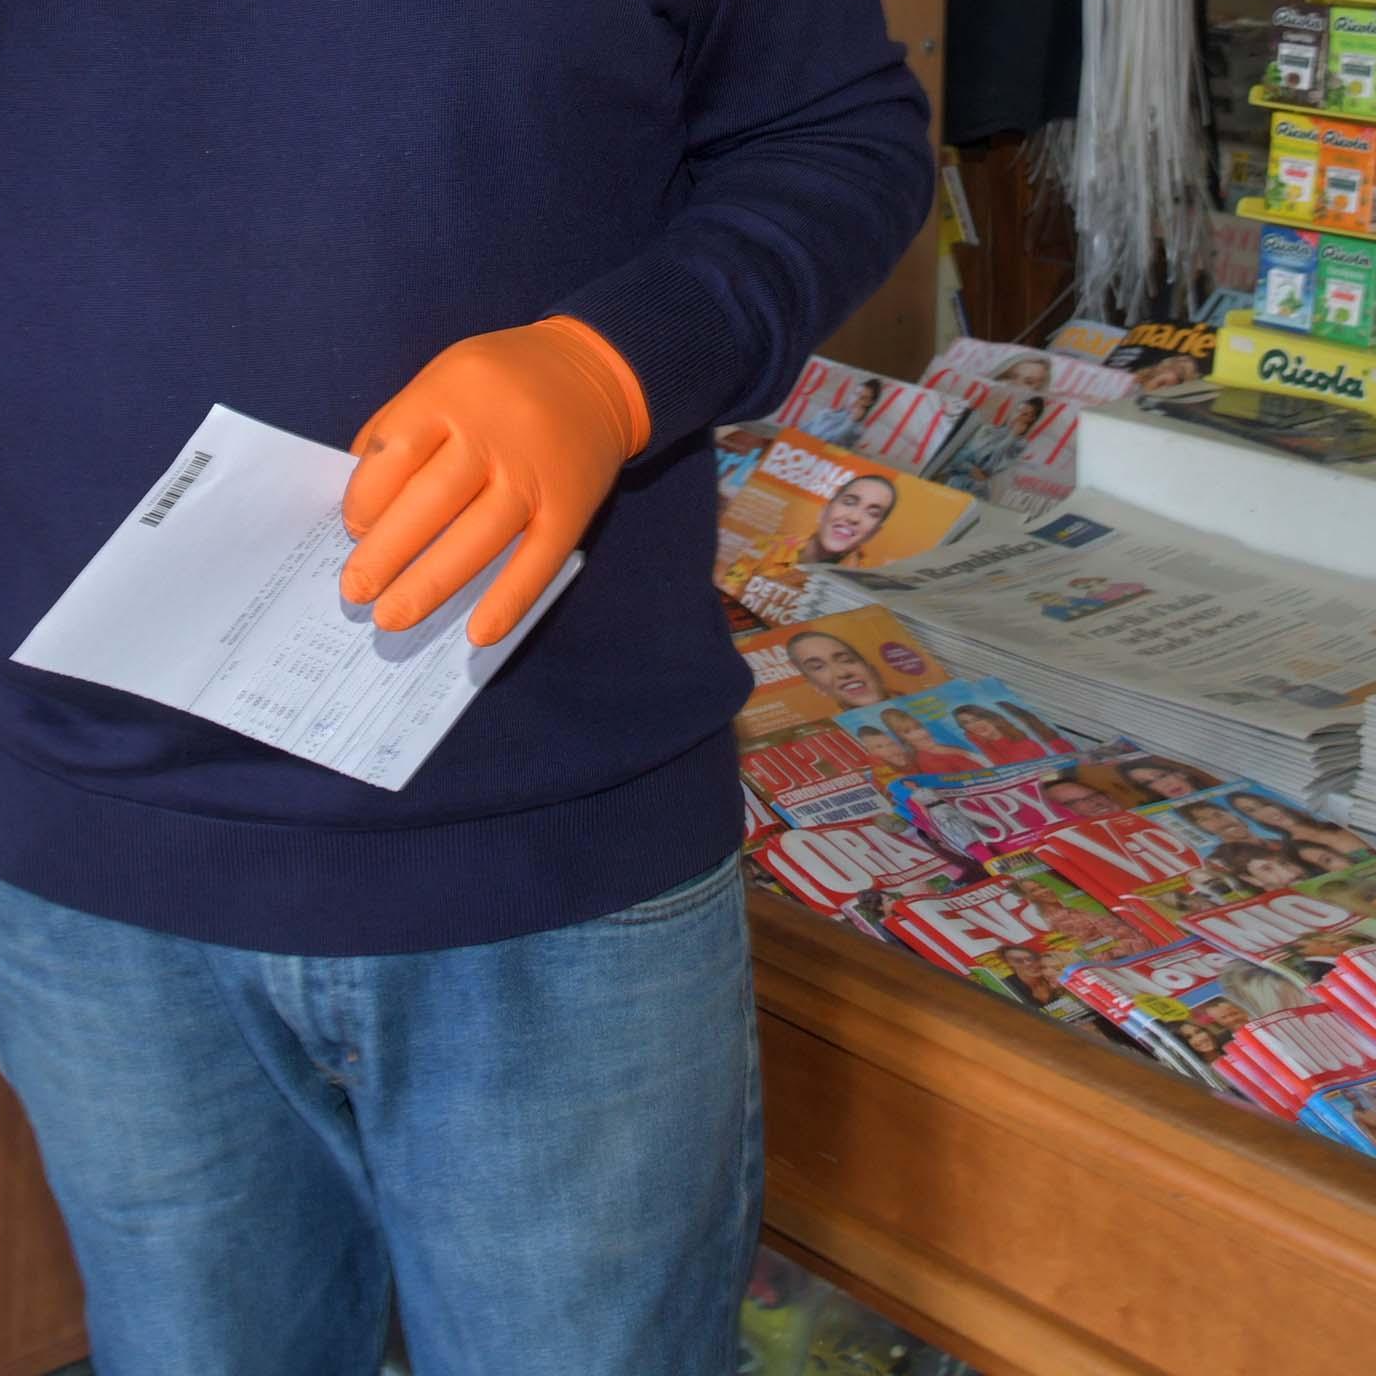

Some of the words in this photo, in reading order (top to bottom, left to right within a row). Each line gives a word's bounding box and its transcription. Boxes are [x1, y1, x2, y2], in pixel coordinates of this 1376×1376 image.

[1121, 321, 1216, 359] marie
[1258, 349, 1365, 400] Ricola
[955, 778, 1067, 844] SPY
[780, 825, 939, 895] ORA
[1198, 895, 1355, 954] MIO
